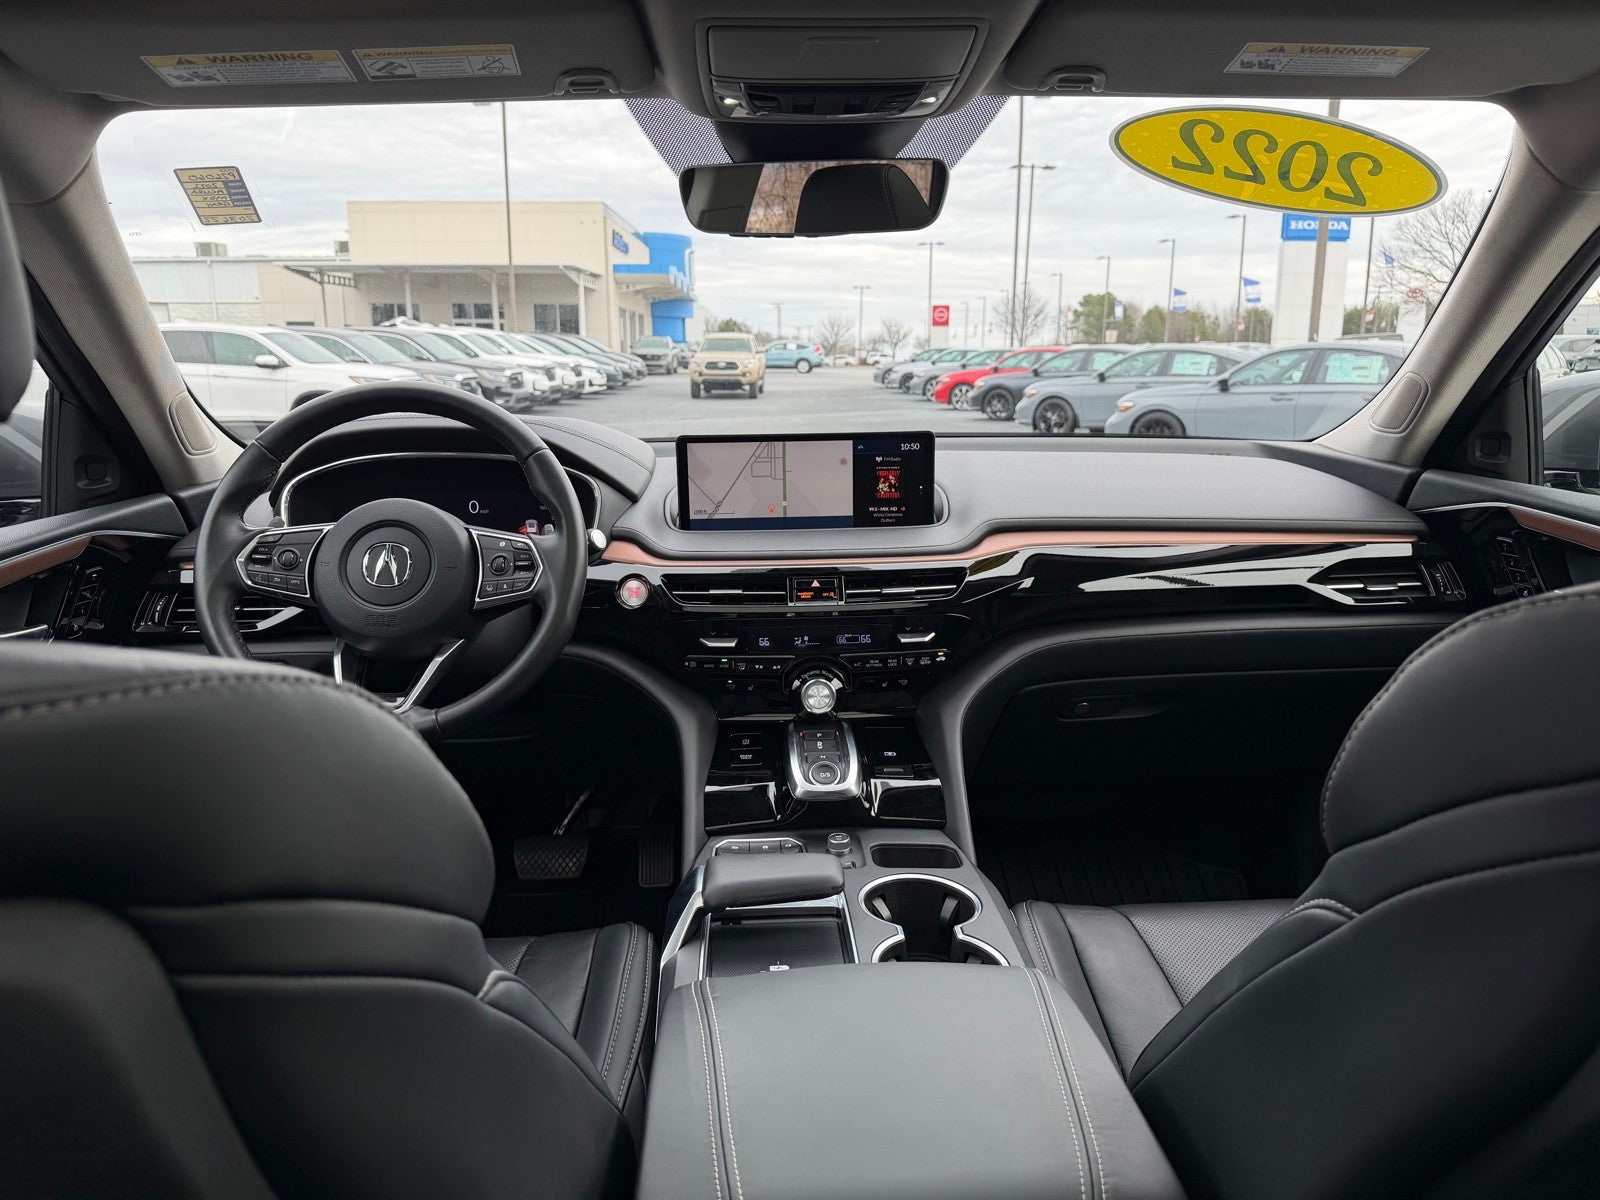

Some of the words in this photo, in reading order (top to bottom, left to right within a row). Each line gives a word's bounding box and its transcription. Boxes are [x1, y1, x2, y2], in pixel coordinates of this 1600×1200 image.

[1300, 46, 1398, 56] WARNING
[205, 52, 314, 64] WARNING
[1289, 219, 1349, 231] HODA
[900, 443, 920, 451] 10:50
[468, 500, 480, 514] 0
[758, 637, 770, 647] 66
[860, 635, 872, 644] 66
[821, 670, 835, 679] Mode
